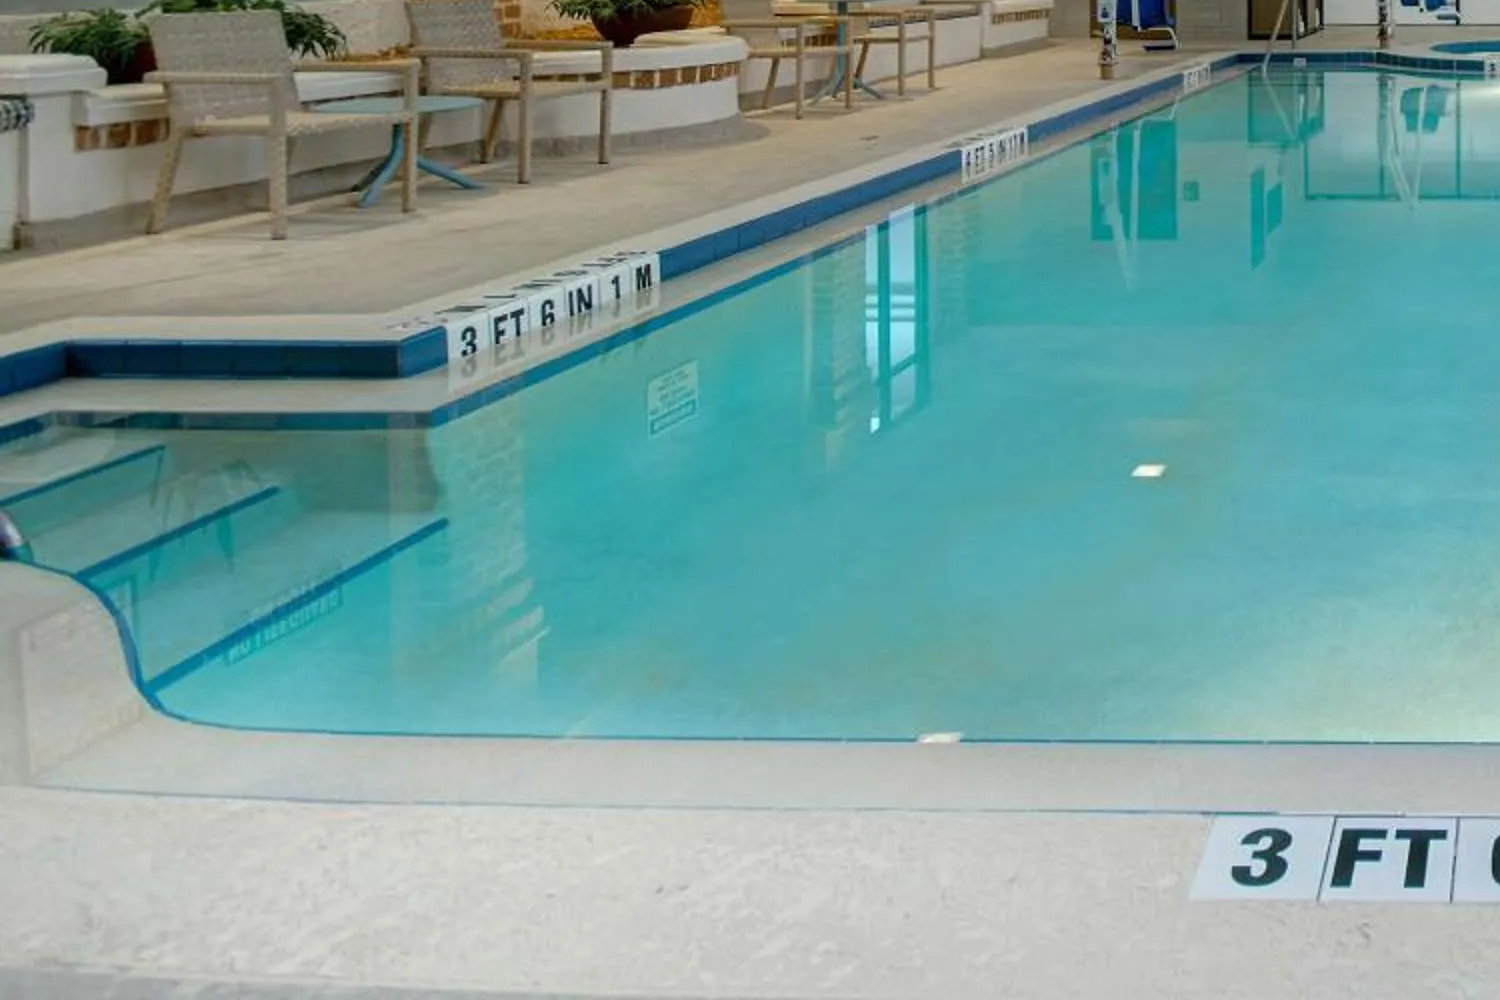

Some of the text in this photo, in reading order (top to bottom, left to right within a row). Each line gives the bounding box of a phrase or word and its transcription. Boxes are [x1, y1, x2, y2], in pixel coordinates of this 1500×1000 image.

[460, 263, 652, 357] 3 FT 6 IN 1 M
[1231, 827, 1293, 887] 3
[1330, 828, 1448, 889] FT
